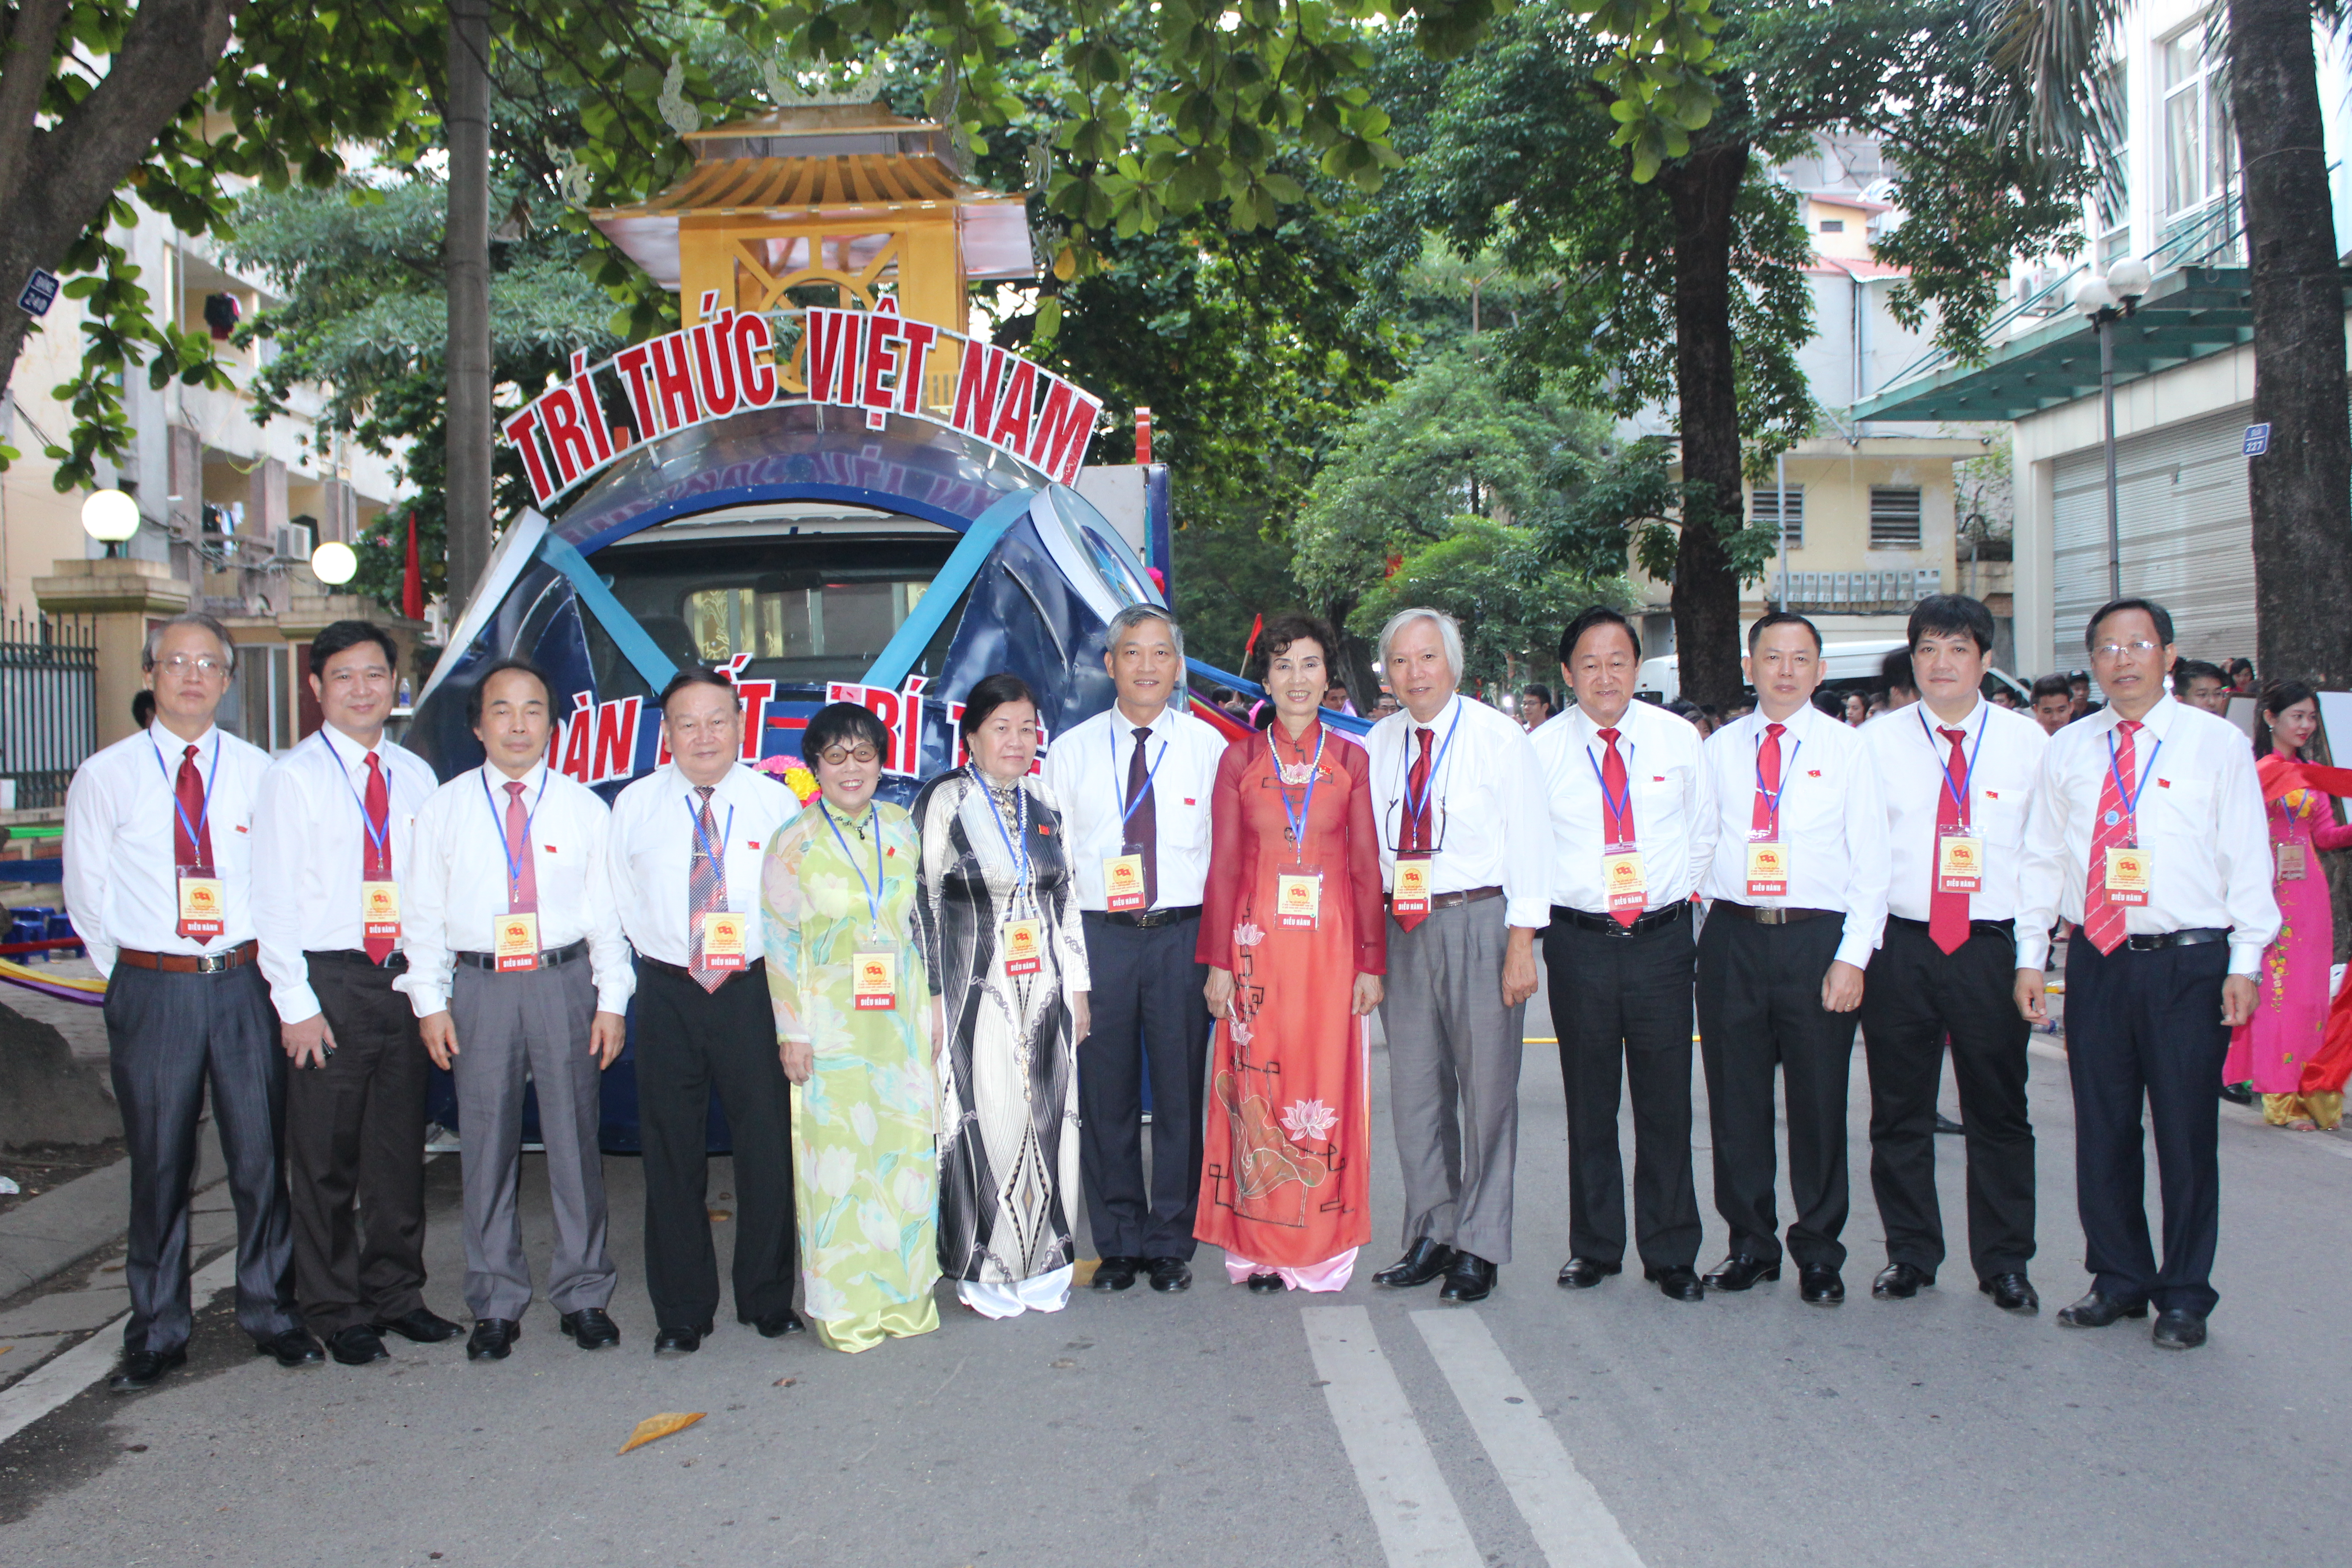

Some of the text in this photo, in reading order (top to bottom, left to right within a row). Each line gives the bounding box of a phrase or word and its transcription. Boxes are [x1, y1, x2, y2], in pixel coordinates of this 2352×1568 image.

[501, 289, 1103, 510] TRÍ THỨC VIỆT NAM
[2245, 441, 2263, 452] 227
[1766, 883, 1781, 892] HÀNH
[1960, 879, 1975, 888] HÀNH
[1125, 897, 1139, 905] HÀNH
[1627, 895, 1642, 904] HÀNH
[2126, 893, 2142, 902] HÀNH
[1410, 902, 1423, 910] HÀNH
[1296, 917, 1310, 926] HÀNH
[202, 923, 218, 931] HÀNH
[381, 925, 396, 933] HÀNH
[516, 958, 532, 966] HÀNH
[724, 957, 740, 966] HÀNH
[1023, 961, 1035, 970] HÀNH
[874, 997, 890, 1006] HÀNH
